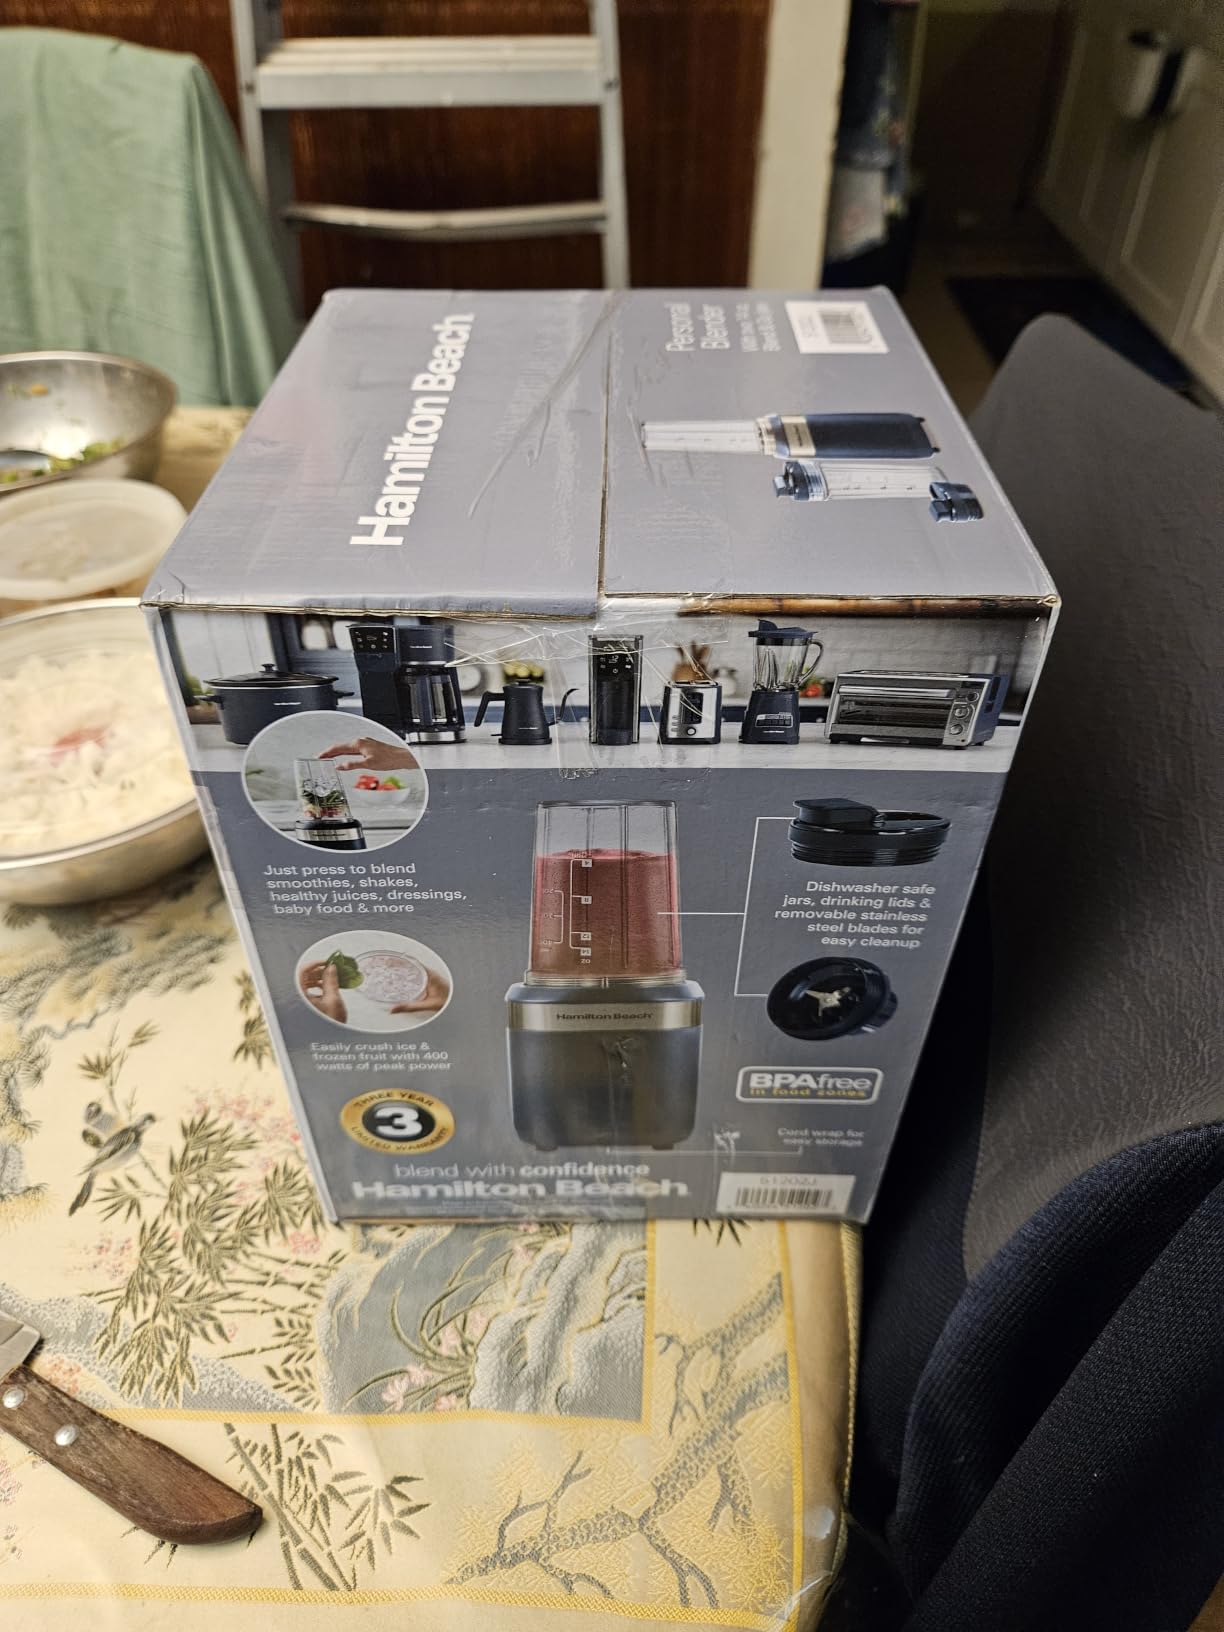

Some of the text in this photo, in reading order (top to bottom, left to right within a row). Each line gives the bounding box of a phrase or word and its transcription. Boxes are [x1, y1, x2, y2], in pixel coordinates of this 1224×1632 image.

[350, 312, 475, 545] Hamilton Beach
[264, 863, 416, 877] Just press to blend
[266, 877, 418, 889] smoothies, shakes,
[806, 881, 937, 895] Dishwasher safe
[270, 889, 467, 903] healthy juices, dressings,
[782, 895, 932, 909] jars, drinking lids &
[273, 903, 414, 915] baby food & more
[774, 909, 928, 922] removable stainless
[807, 923, 925, 935] steel blades for
[821, 936, 921, 949] easy cleanup
[614, 1012, 653, 1020] Beach
[311, 1042, 430, 1052] Easily crush ice &
[312, 1051, 449, 1060] frozen fruit with 400
[317, 1062, 452, 1072] watts of peak power
[772, 1087, 810, 1096] food
[816, 1088, 865, 1097] zones
[400, 1091, 434, 1107] YEAR
[375, 1106, 423, 1138] 3
[394, 1161, 650, 1178] blend with confidence
[352, 1178, 689, 1198] Hamilton Beach
